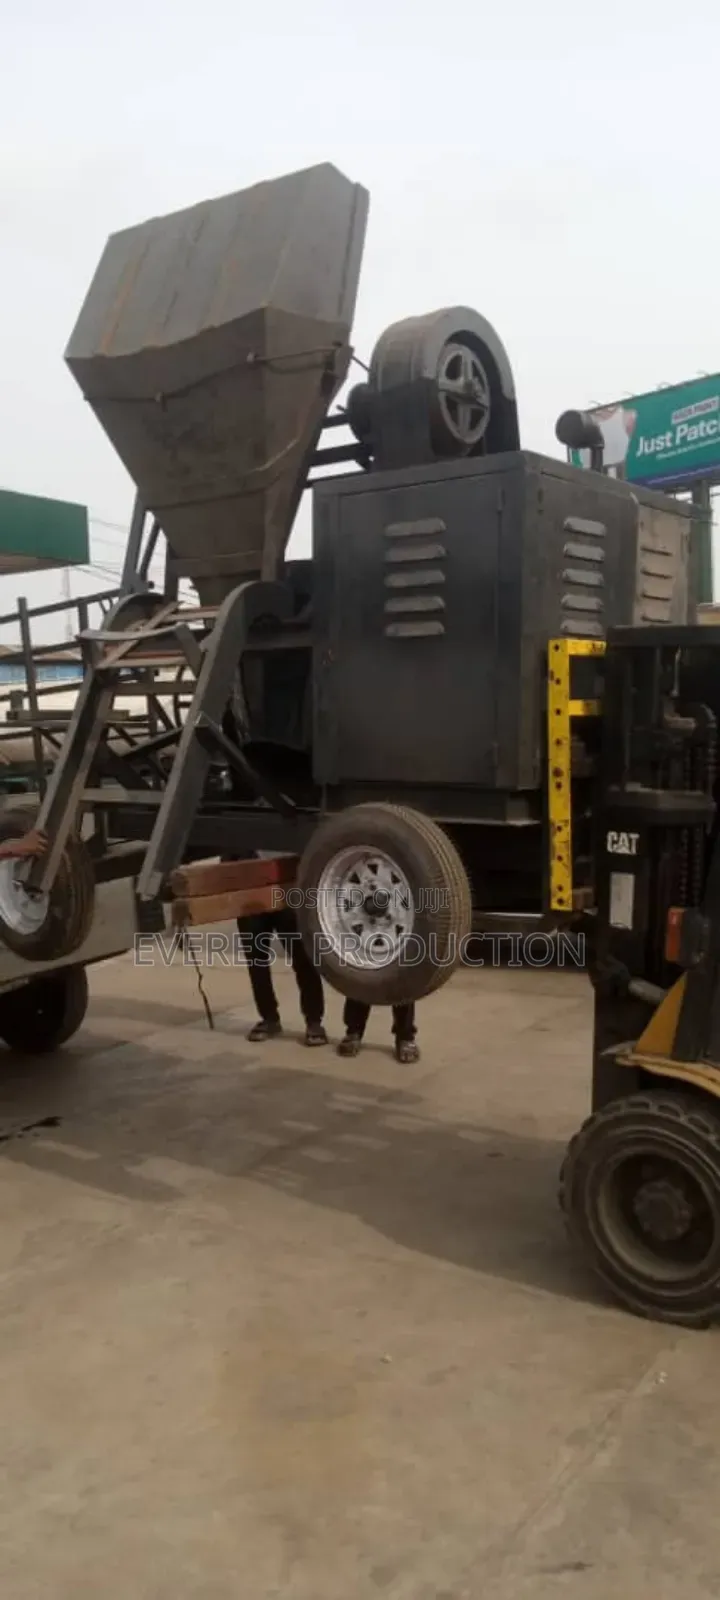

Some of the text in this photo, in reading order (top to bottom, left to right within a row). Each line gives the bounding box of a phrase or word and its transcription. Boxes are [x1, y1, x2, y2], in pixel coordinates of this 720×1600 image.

[636, 431, 673, 457] Just
[675, 415, 720, 445] Patc
[607, 831, 640, 855] CAT
